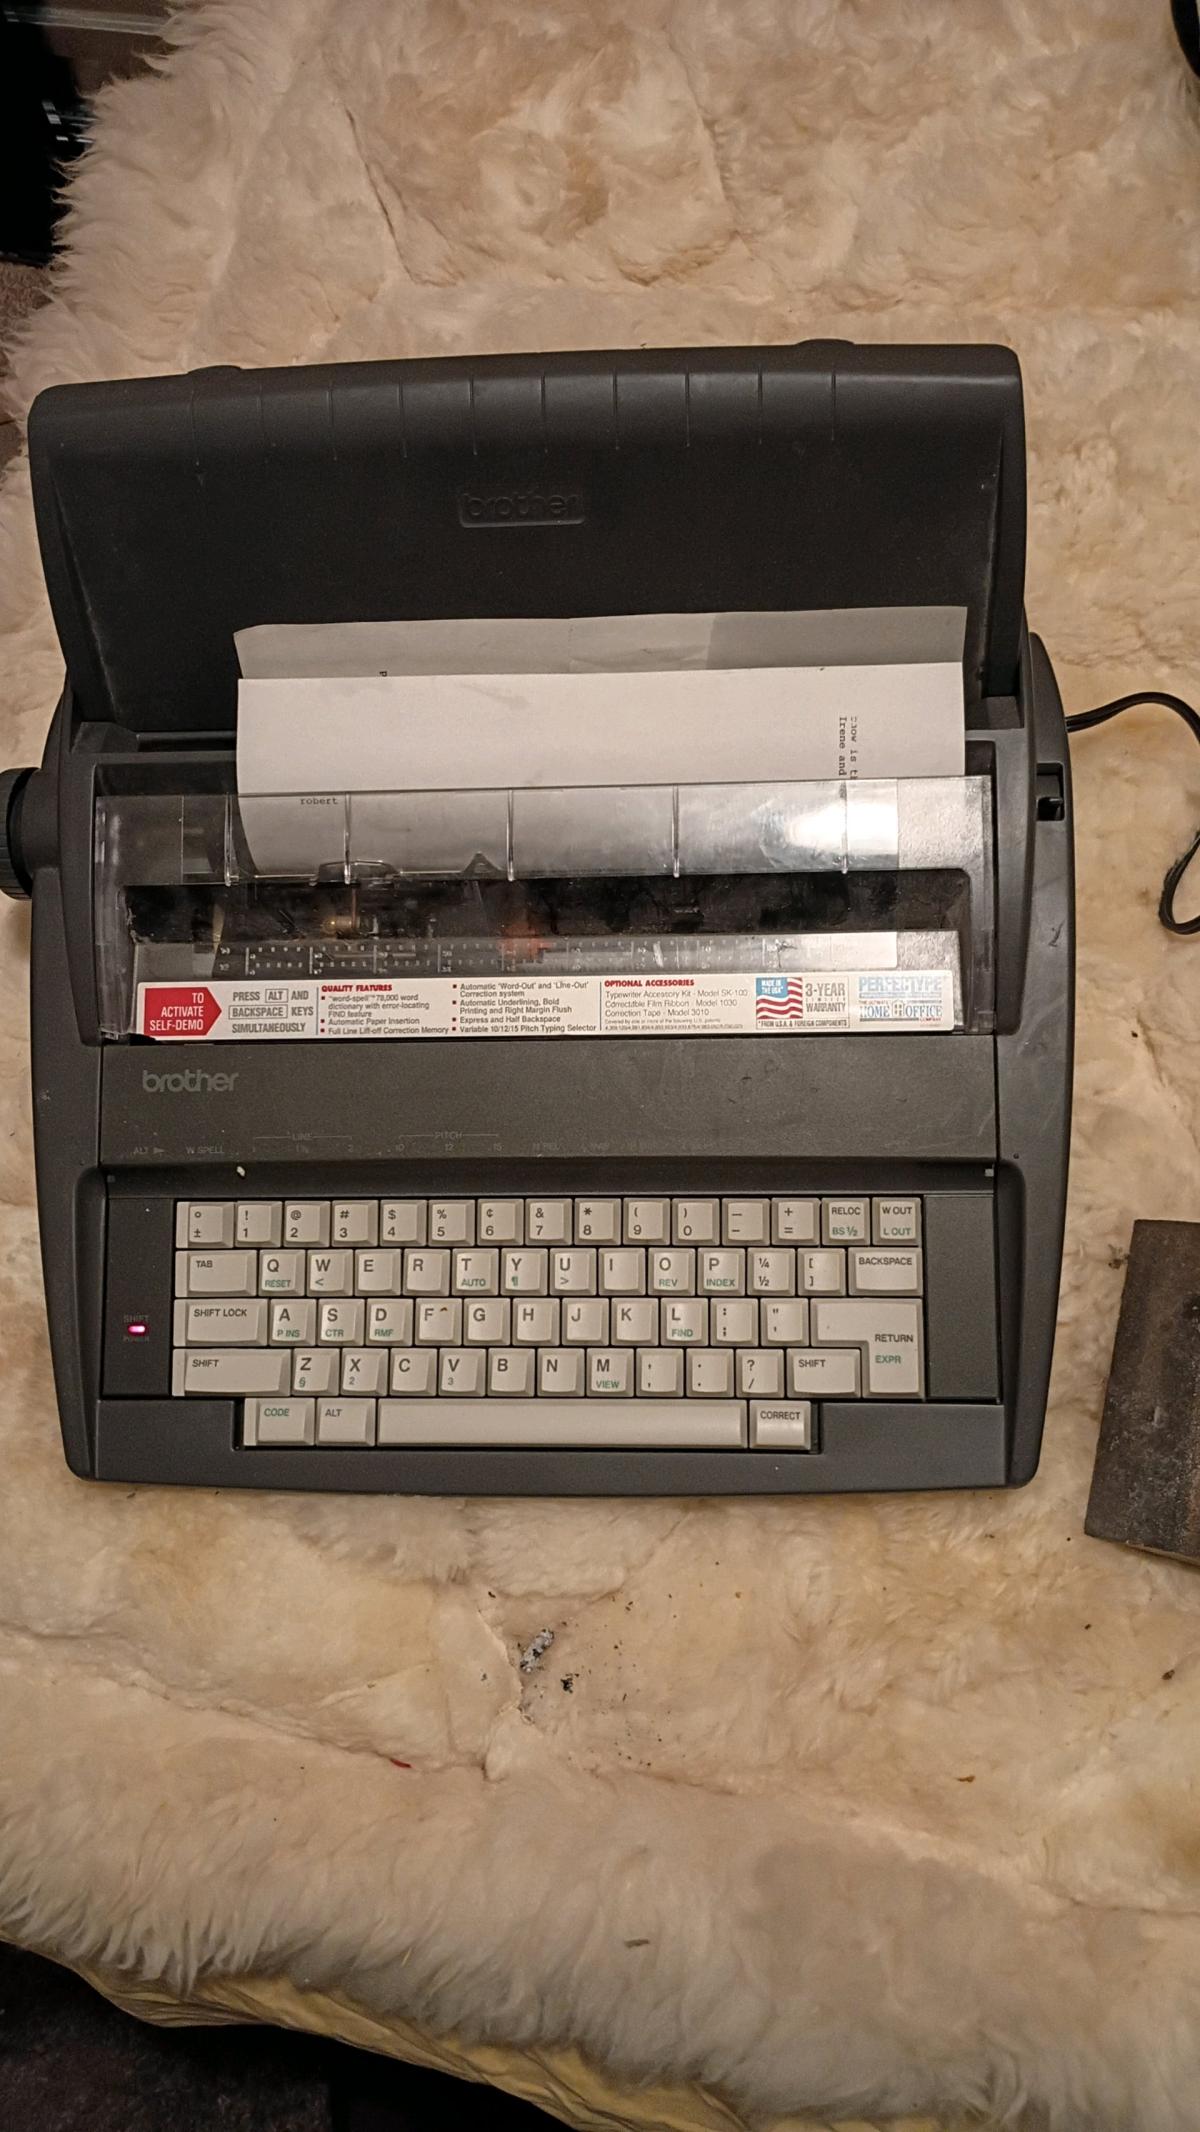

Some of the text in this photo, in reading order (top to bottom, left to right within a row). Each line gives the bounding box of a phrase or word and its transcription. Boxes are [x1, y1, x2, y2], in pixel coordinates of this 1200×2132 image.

[463, 489, 580, 517] brother
[839, 717, 847, 749] Irene
[850, 749, 858, 762] is
[838, 755, 847, 776] and
[300, 797, 338, 805] robert
[322, 984, 393, 993] QUALITY FEATURES
[645, 979, 695, 987] ACCESSORIES
[499, 991, 525, 999] system
[605, 991, 641, 999] Typewriter
[643, 990, 679, 999] Accessory
[697, 989, 719, 997] Model
[805, 983, 845, 997] 3-YEAR
[192, 993, 204, 1005] TO
[232, 990, 309, 1002] PRESS ALT AND
[328, 1003, 363, 1012] dictionary
[382, 1001, 430, 1010] error-locating
[647, 999, 662, 1007] Film
[664, 999, 690, 1007] Ribbon
[695, 999, 718, 1007] Model
[720, 998, 737, 1006] 1030
[806, 1003, 846, 1013] WARRANTY
[161, 1006, 204, 1018] ACTIVATE
[232, 1006, 314, 1018] BACKSPACE KEYS
[347, 1010, 372, 1018] feature
[460, 1007, 488, 1015] Printing
[505, 1006, 524, 1015] Right
[526, 1006, 550, 1014] Margin
[552, 1005, 572, 1013] Flush
[605, 1008, 709, 1017] Correction Tape Model 3010
[905, 1005, 943, 1017] OFFICE
[149, 1019, 204, 1032] SELF-DEMO
[328, 1017, 420, 1026] Automatic Paper Insertion
[460, 1016, 488, 1025] Express
[522, 1015, 561, 1024] Backspace
[232, 1022, 306, 1034] SIMULTANEOUSLY
[346, 1027, 358, 1035] Line
[384, 1026, 420, 1034] Correction
[421, 1026, 450, 1035] Memory
[460, 1025, 488, 1033] Variable
[541, 1025, 565, 1034] Typing
[567, 1024, 596, 1032] Selector
[142, 1069, 239, 1093] brother
[831, 1207, 861, 1216] RELOC
[882, 1206, 913, 1215] W OUT
[243, 1228, 248, 1238] 1
[290, 1228, 298, 1238] 2
[339, 1227, 348, 1238] 3
[387, 1227, 396, 1237] 4
[437, 1226, 446, 1237] 5
[485, 1226, 494, 1236] 6
[536, 1225, 543, 1235] 7
[583, 1225, 592, 1235] 8
[633, 1224, 642, 1235] 9
[683, 1225, 692, 1236] 0
[832, 1226, 858, 1237] BS ½
[883, 1227, 912, 1236] L OUT
[196, 1260, 213, 1268] TAB
[267, 1259, 280, 1273] Q
[315, 1259, 331, 1272] W
[364, 1259, 374, 1272] E
[413, 1259, 424, 1271] R
[461, 1258, 472, 1271] T
[511, 1258, 522, 1271] Y
[560, 1258, 571, 1271] U
[609, 1258, 613, 1271] I
[659, 1257, 672, 1271] O
[709, 1258, 720, 1271] P
[759, 1258, 770, 1269] ¼
[858, 1257, 912, 1266] BACKSPACE
[265, 1279, 291, 1288] RESET
[461, 1279, 486, 1287] AUTO
[659, 1279, 678, 1287] REV
[706, 1279, 736, 1287] INDEX
[759, 1276, 769, 1287] ½
[194, 1308, 247, 1318] SHIFT LOCK
[279, 1308, 291, 1322] A
[327, 1308, 338, 1322] S
[376, 1308, 387, 1321] D
[424, 1308, 435, 1321] F
[473, 1308, 486, 1322] G
[523, 1308, 534, 1321] H
[571, 1308, 581, 1322] J
[621, 1308, 632, 1321] K
[671, 1308, 681, 1321] L
[277, 1329, 300, 1338] P INS
[325, 1329, 344, 1337] CTR
[374, 1329, 394, 1337] RMF
[671, 1329, 694, 1337] FIND
[875, 1334, 914, 1343] RETURN
[192, 1359, 219, 1368] SHIFT
[300, 1357, 312, 1371] Z
[349, 1358, 361, 1372] X
[398, 1358, 411, 1372] C
[448, 1358, 460, 1372] V
[497, 1358, 508, 1371] B
[798, 1359, 826, 1368] SHIFT
[875, 1355, 901, 1364] EXPR
[546, 1359, 558, 1372] N
[597, 1359, 610, 1372] M
[596, 1380, 619, 1388] VIEW
[264, 1408, 290, 1417] CODE
[325, 1409, 343, 1417] ALT
[760, 1410, 801, 1421] CORRECT
